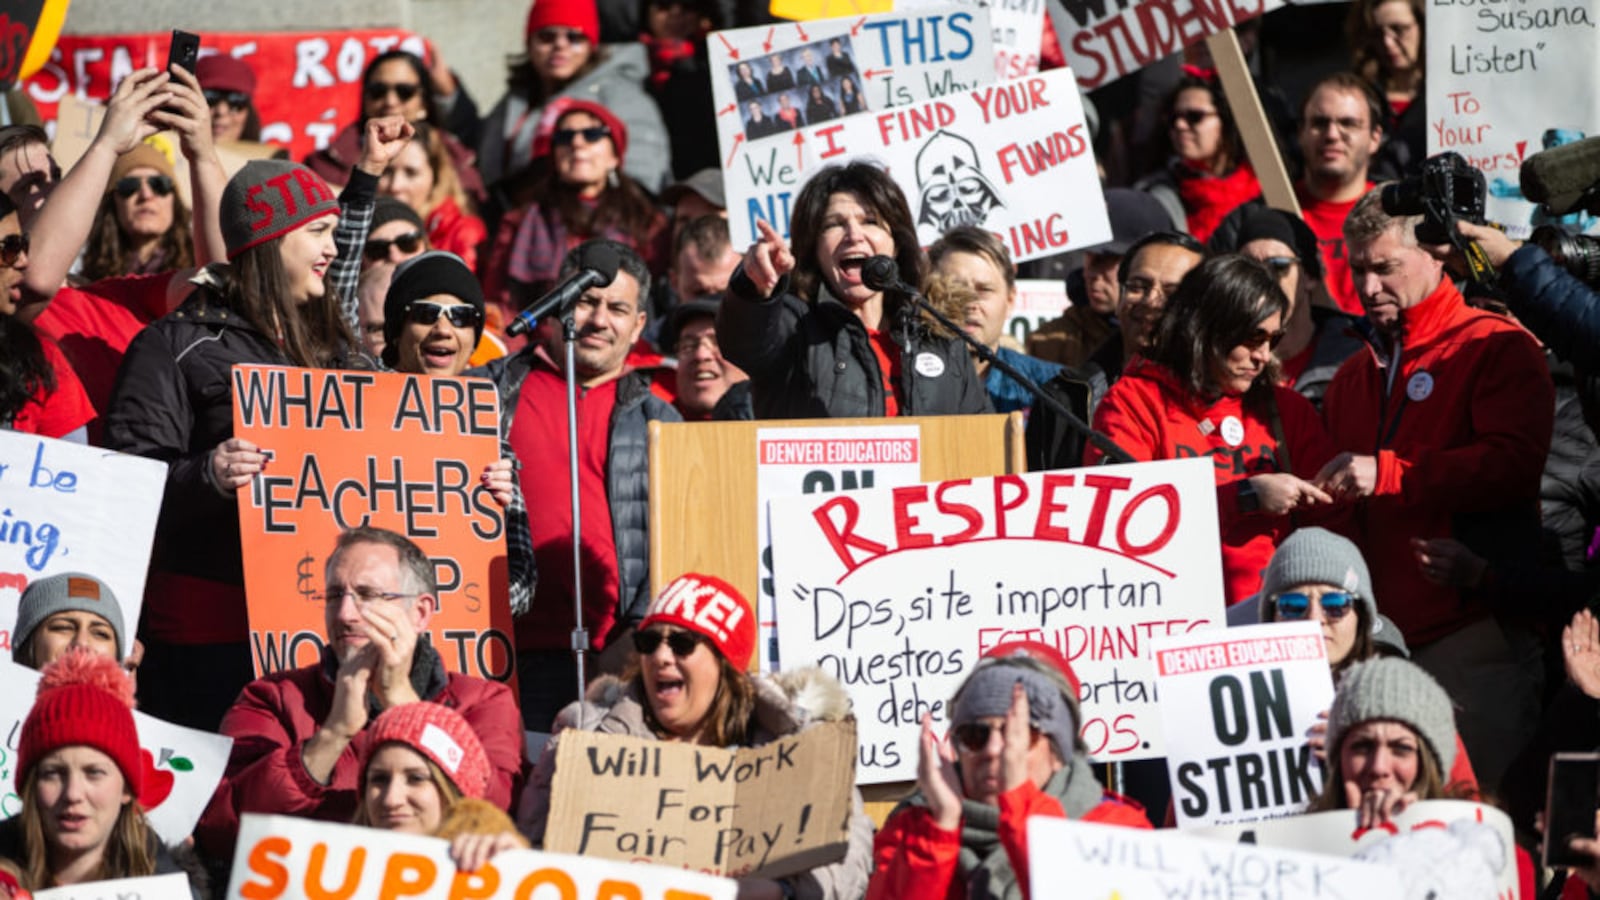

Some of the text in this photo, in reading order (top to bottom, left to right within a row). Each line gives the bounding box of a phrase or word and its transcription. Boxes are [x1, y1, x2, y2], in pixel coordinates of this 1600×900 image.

[863, 12, 974, 66] THIS
[816, 80, 1050, 158] I FIND YOUR
[883, 76, 913, 108] Is
[1447, 91, 1480, 115] To
[997, 124, 1086, 184] FUNDS
[1433, 118, 1491, 148] Your
[745, 148, 797, 187] We
[235, 370, 499, 437] WHAT ARE
[29, 441, 78, 493] be
[766, 441, 913, 464] DENVER EDUCATORS
[813, 474, 1182, 571] RESPETO
[655, 578, 745, 643] IKE!
[996, 568, 1162, 626] importan
[443, 629, 514, 683] TO
[818, 638, 964, 681] nuestros
[1165, 635, 1321, 673] DENVER EDUCATORS
[1209, 669, 1295, 746] ON
[587, 743, 799, 783] Will Work
[1177, 743, 1326, 819] STRIK
[657, 789, 740, 823] For
[578, 813, 687, 857] Fair
[240, 837, 714, 900] SUPPO
[1076, 834, 1343, 898] WILL WORK
